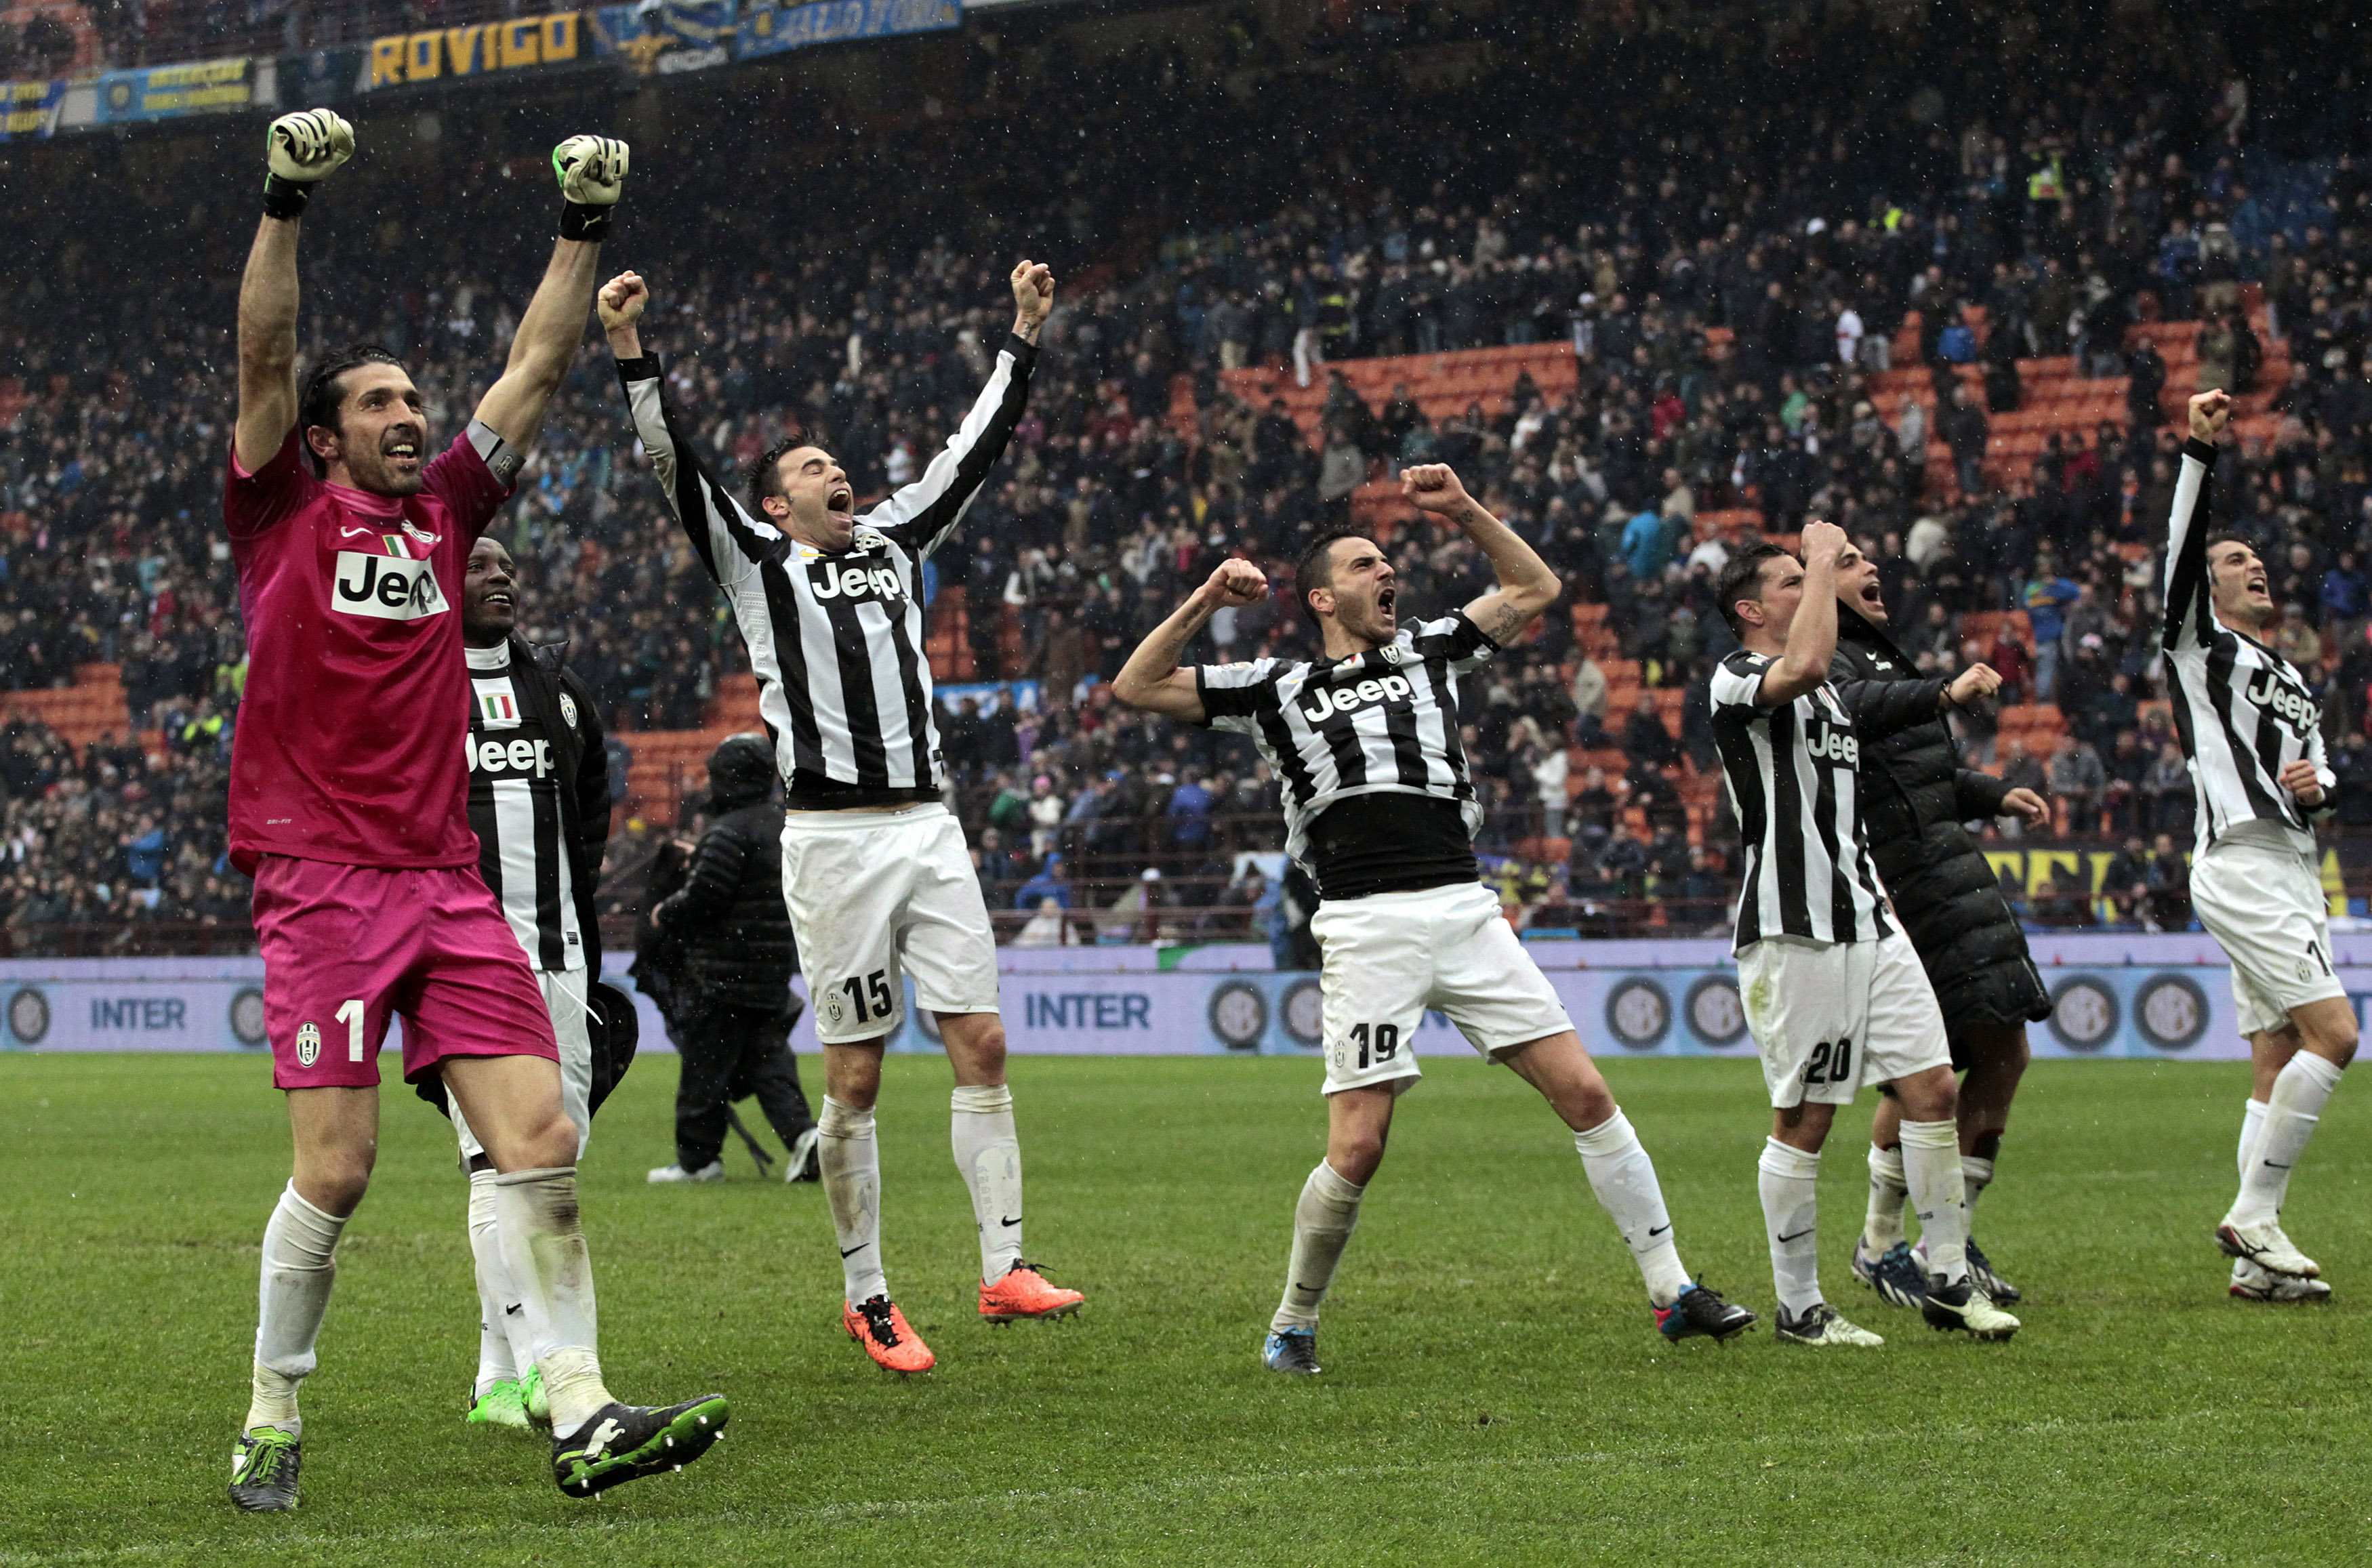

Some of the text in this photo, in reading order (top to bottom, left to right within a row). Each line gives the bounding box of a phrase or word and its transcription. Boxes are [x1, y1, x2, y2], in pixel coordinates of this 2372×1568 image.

[371, 11, 578, 86] ROVIGO
[1304, 675, 1410, 723] Jeep
[2247, 673, 2316, 730] Jeep
[1807, 720, 1860, 772] Jee
[91, 998, 186, 1030] INTER
[842, 968, 893, 1024] 15
[1025, 993, 1150, 1029] INTER
[334, 999, 365, 1062] 1
[1349, 1023, 1399, 1069] 19
[1804, 1037, 1852, 1084] 20
